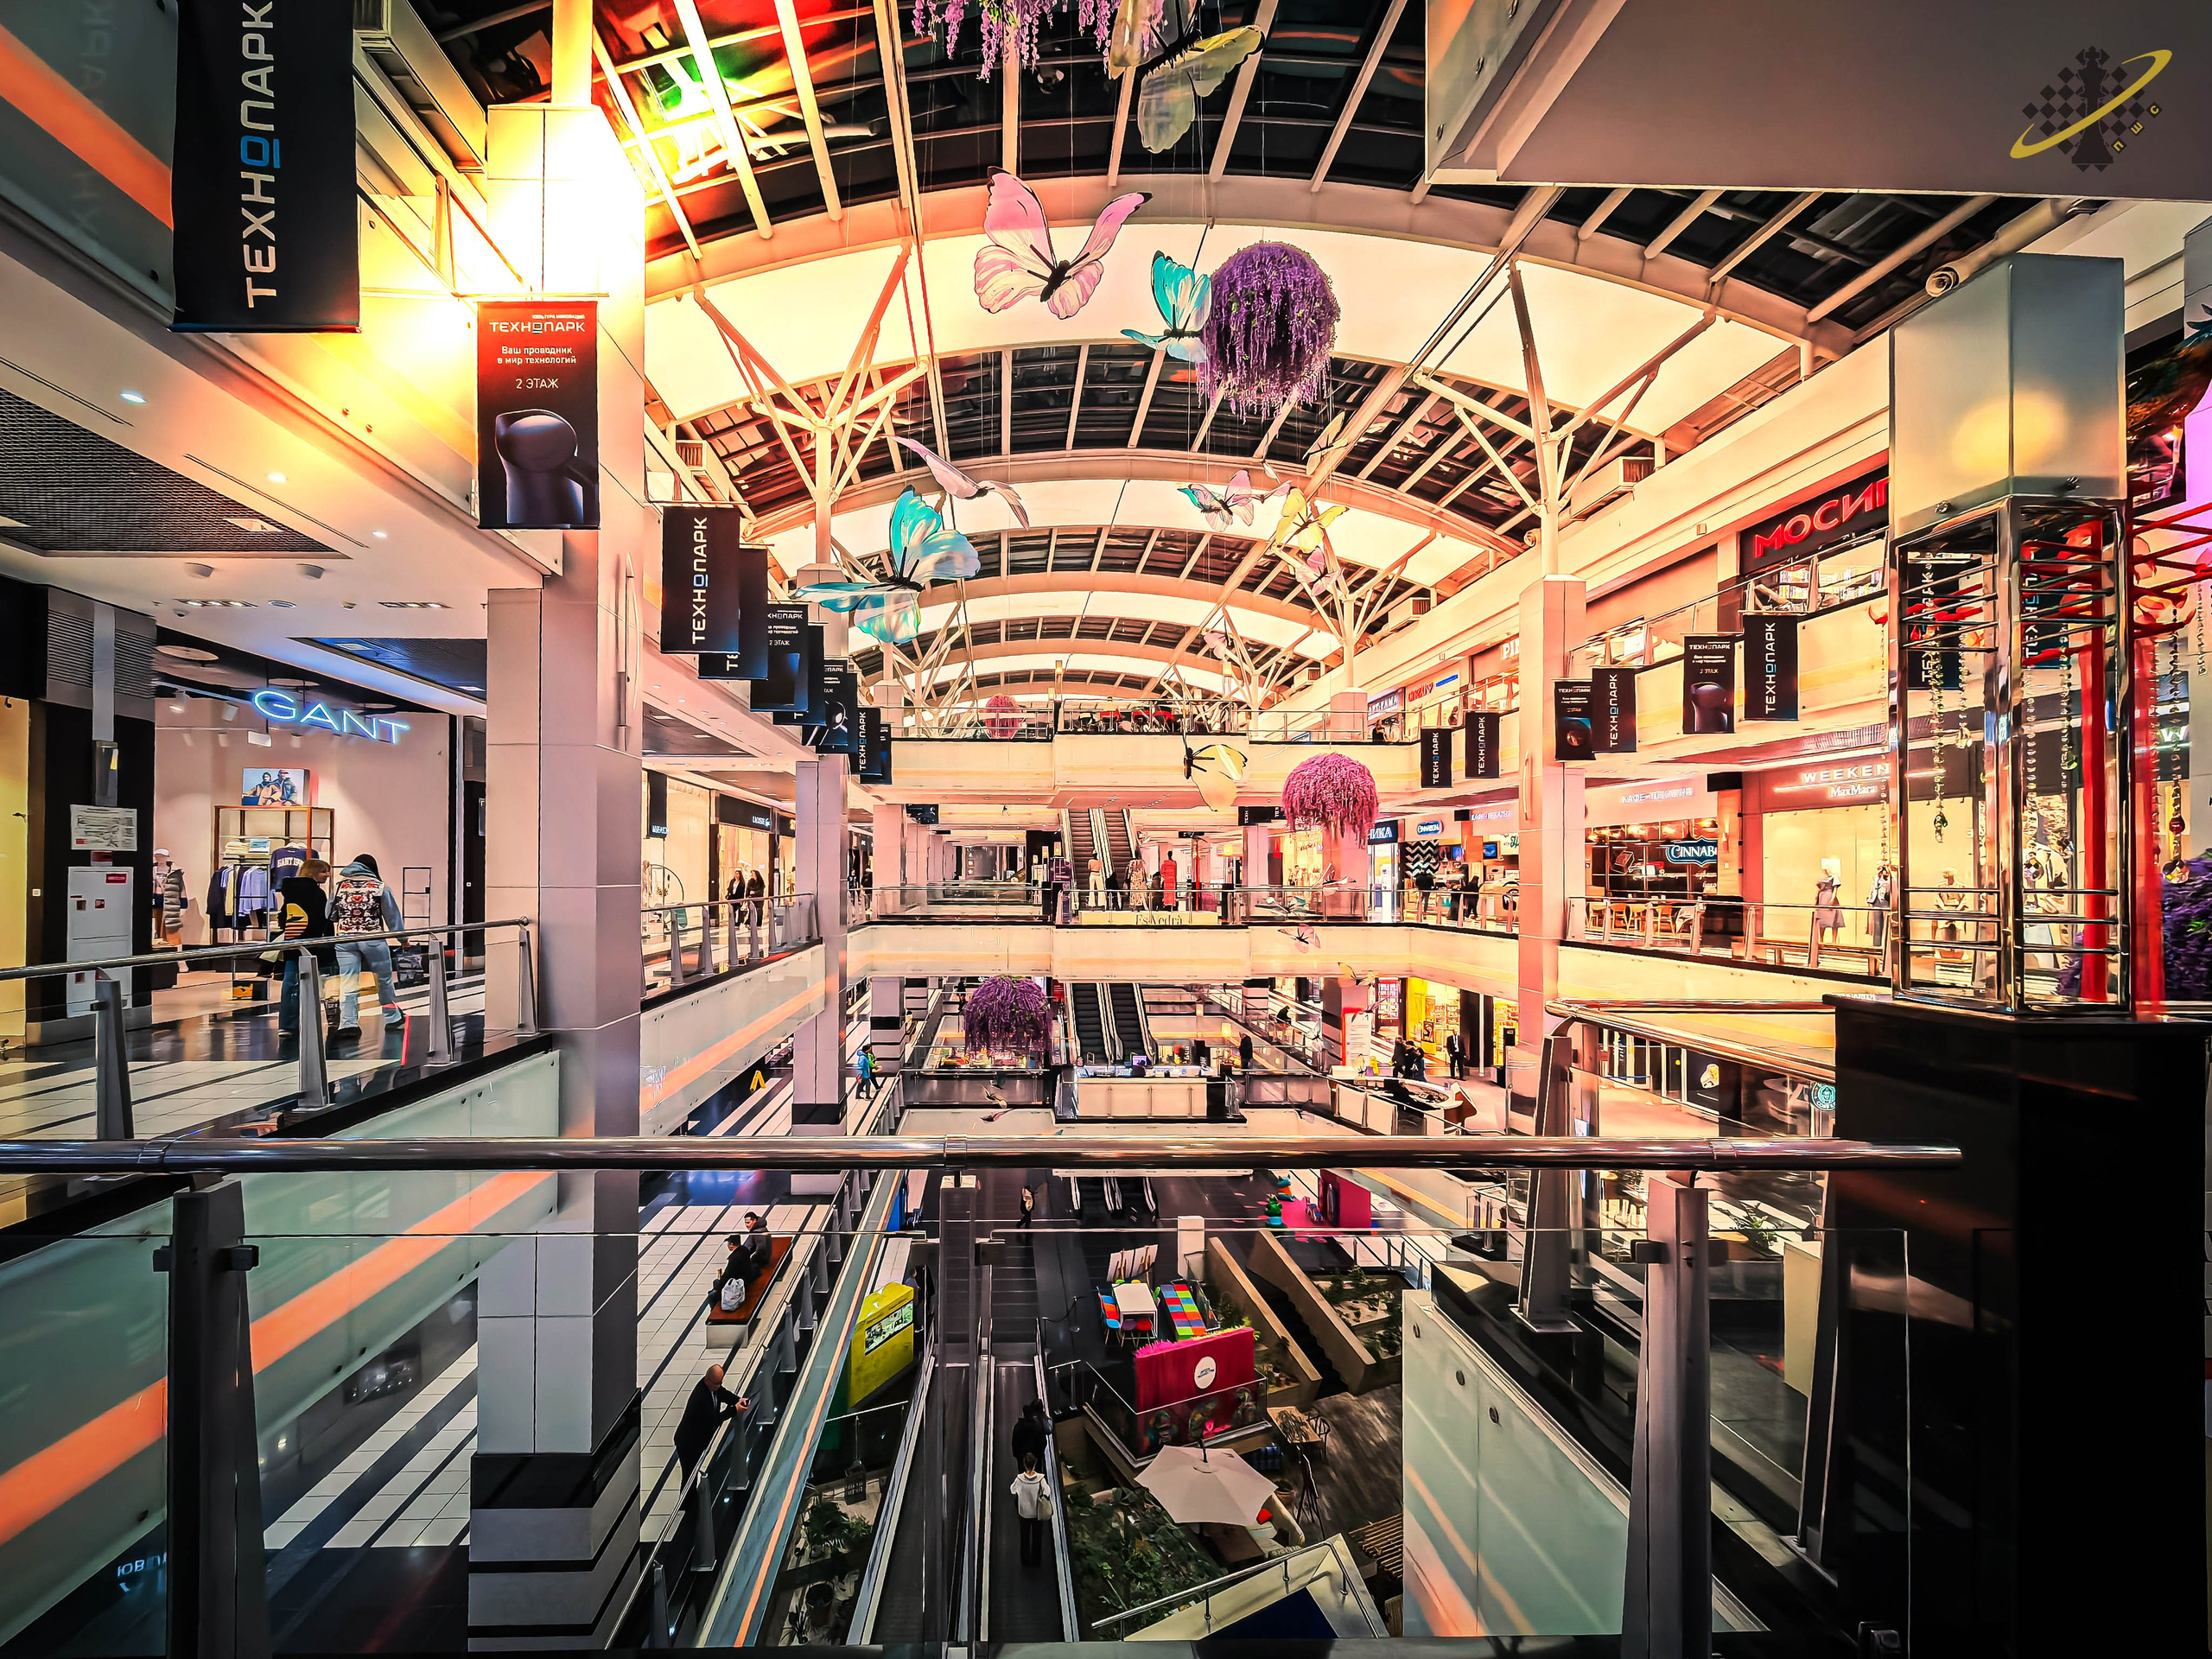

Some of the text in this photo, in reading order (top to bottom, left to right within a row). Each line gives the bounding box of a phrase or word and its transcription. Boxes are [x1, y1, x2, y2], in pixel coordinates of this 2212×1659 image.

[240, 1, 280, 308] ТЕХНОПАРК
[489, 321, 586, 334] ТЕХНОПАРК
[501, 346, 572, 355] Ваш проводник
[515, 378, 559, 389] 2 ЭТАЖ
[692, 517, 709, 645] ТЕХНОПАРК
[1765, 622, 1777, 715] ТЕХНОПАРК
[254, 690, 410, 745] GANT
[1610, 674, 1618, 747] ТЕХНОПАРК
[1803, 762, 1891, 784] WEEKEN
[1830, 784, 1876, 797] MaxMara
